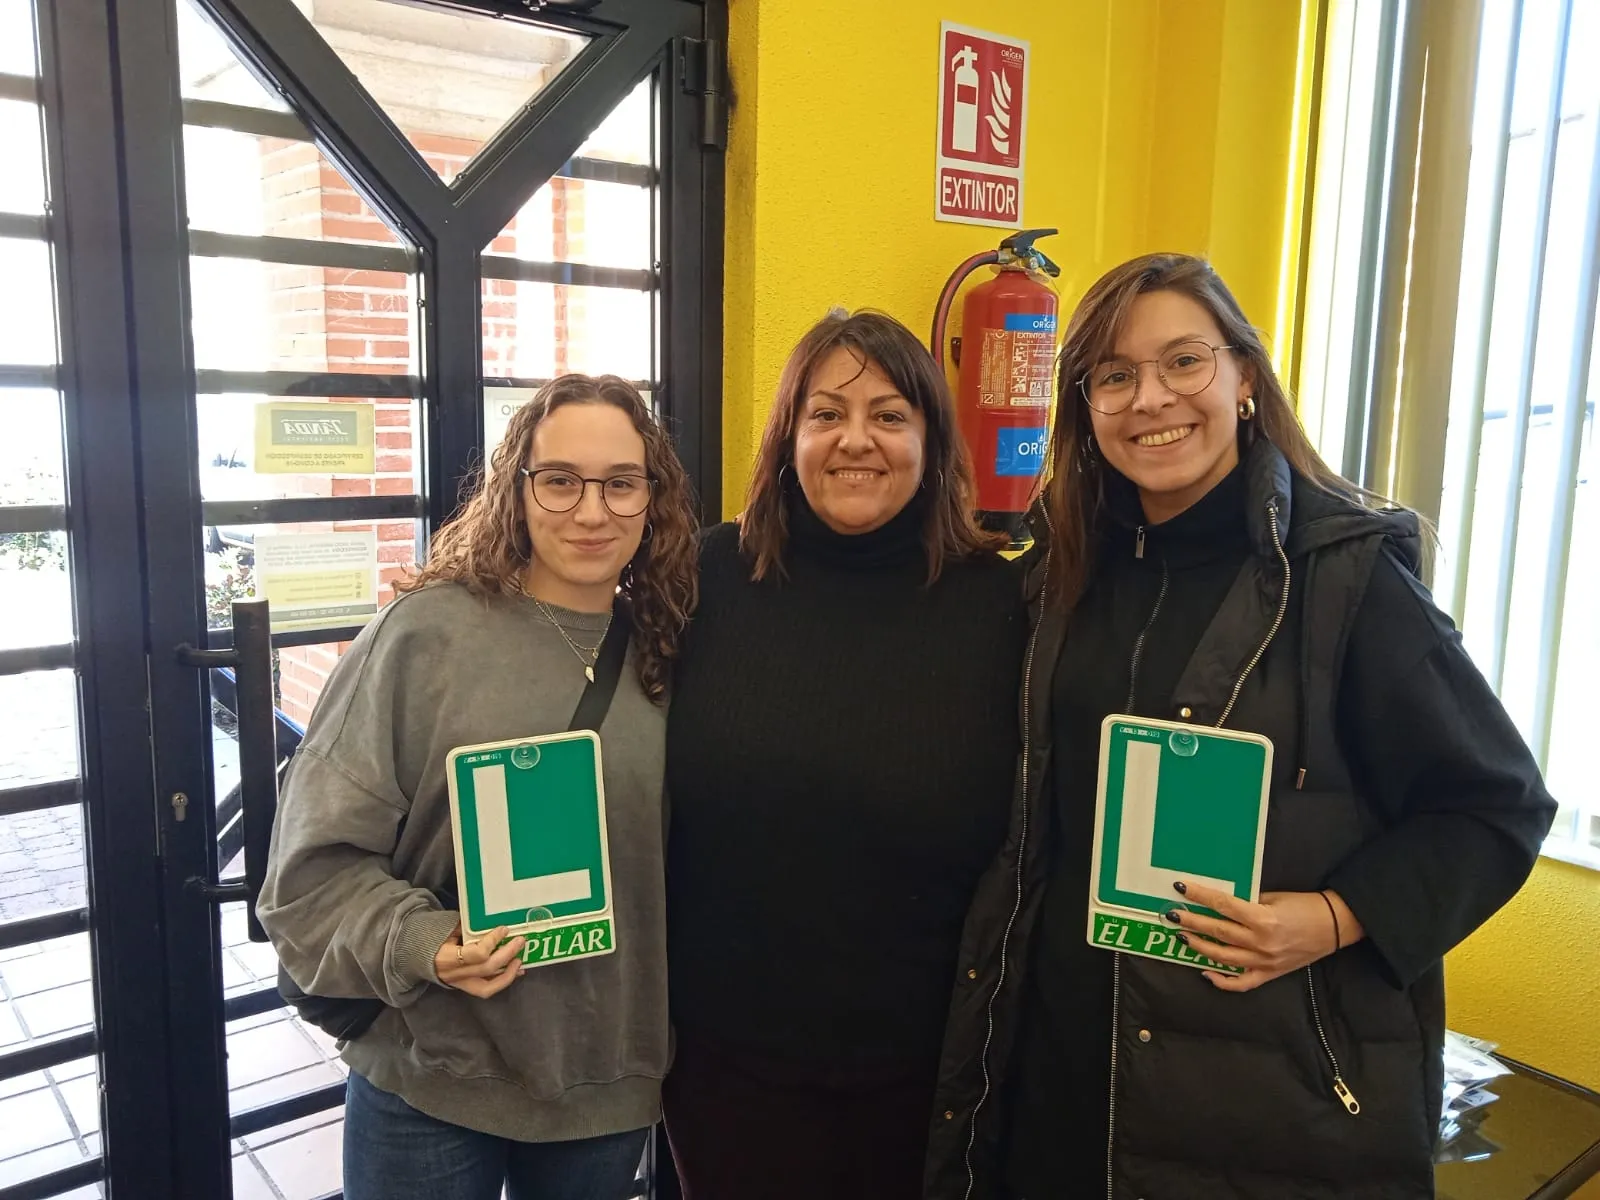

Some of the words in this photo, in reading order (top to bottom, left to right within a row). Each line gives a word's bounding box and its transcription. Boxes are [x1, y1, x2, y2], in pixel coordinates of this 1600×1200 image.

[942, 176, 1016, 215] EXTINTOR
[473, 764, 592, 916] L
[1115, 739, 1235, 903] L
[522, 928, 605, 963] PILAR
[1098, 922, 1133, 948] EL
